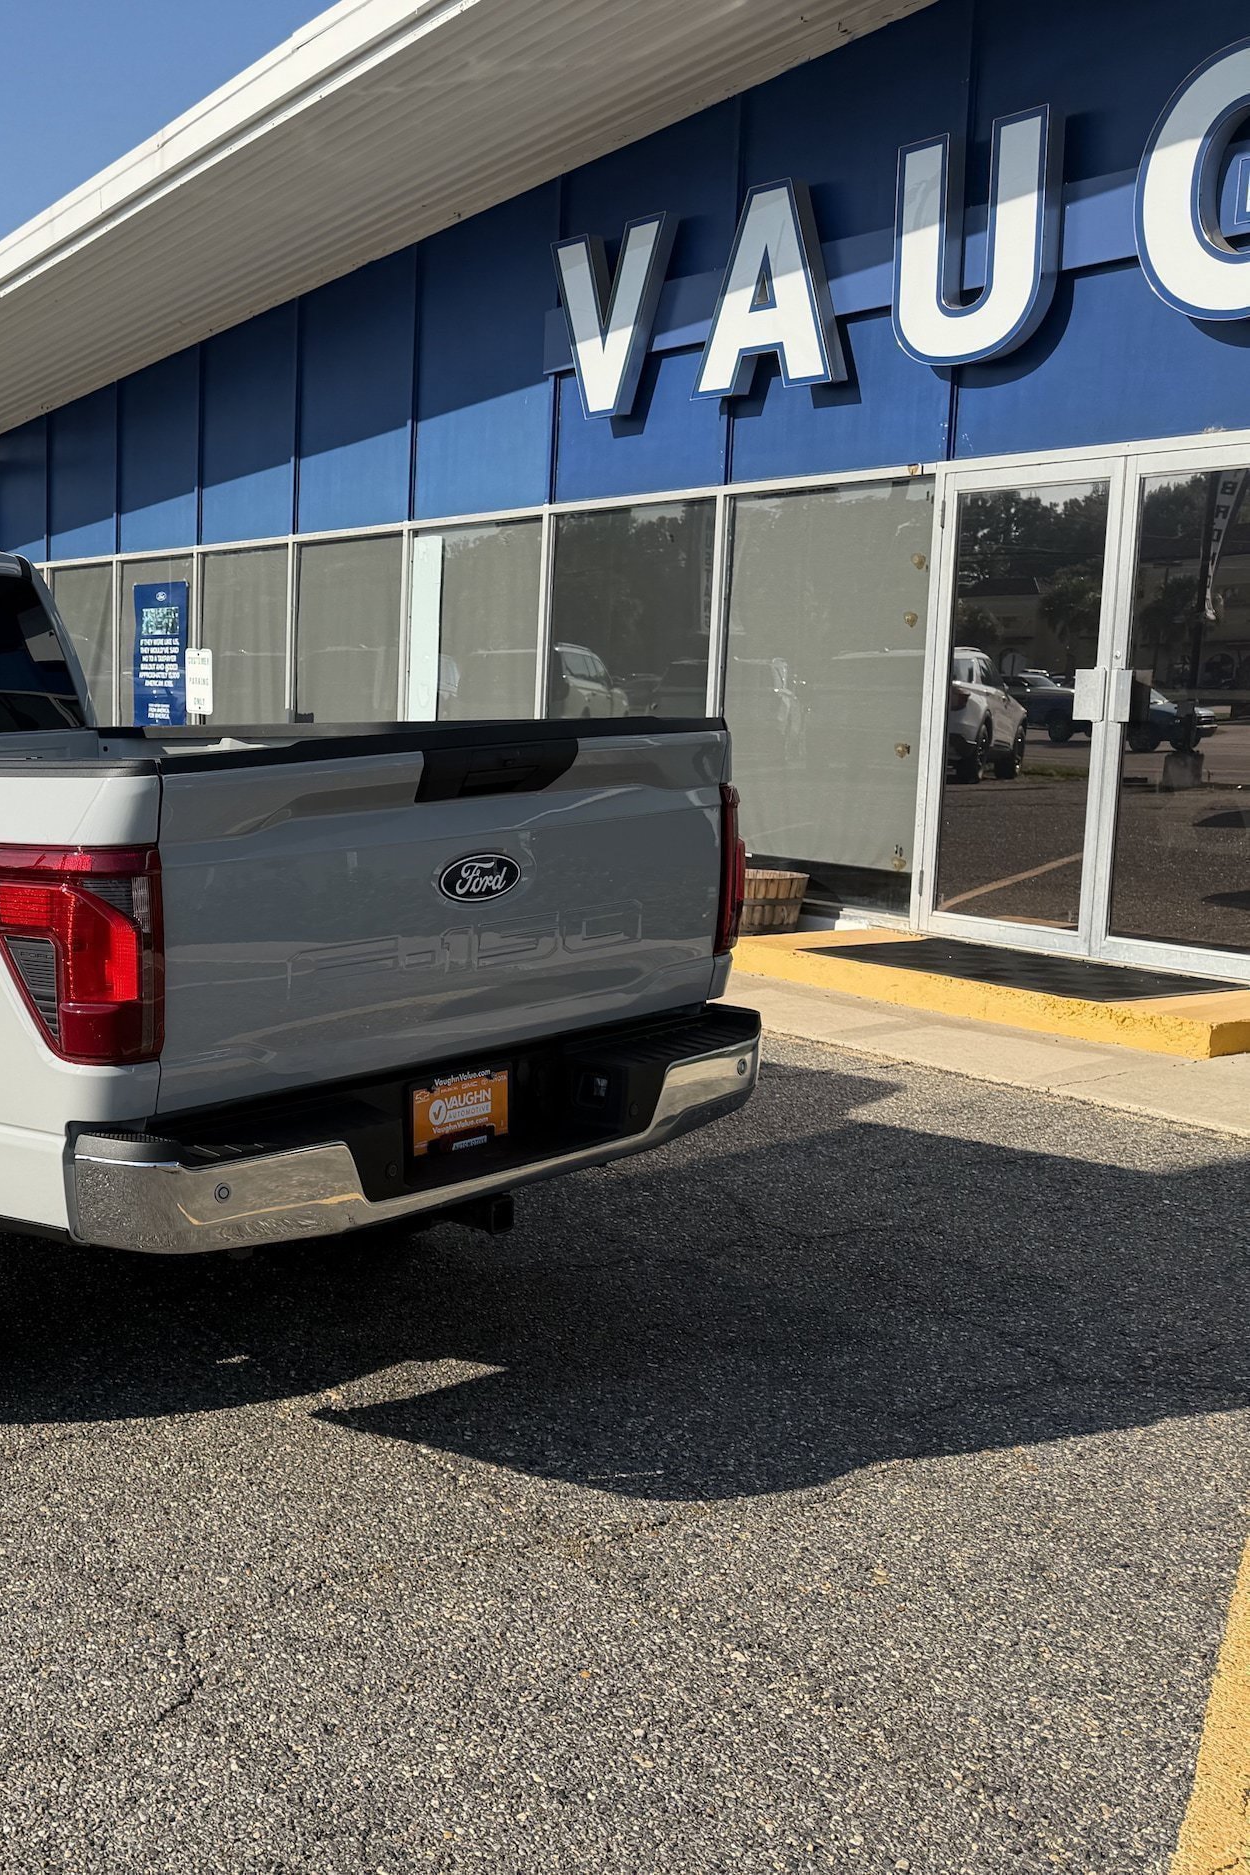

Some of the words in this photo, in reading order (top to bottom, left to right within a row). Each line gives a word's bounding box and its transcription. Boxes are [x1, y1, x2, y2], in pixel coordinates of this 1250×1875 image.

[455, 861, 508, 895] Ford
[286, 901, 644, 1000] F-150
[444, 1087, 492, 1110] VAUGHN
[448, 1103, 490, 1119] AUTOMOTIVE
